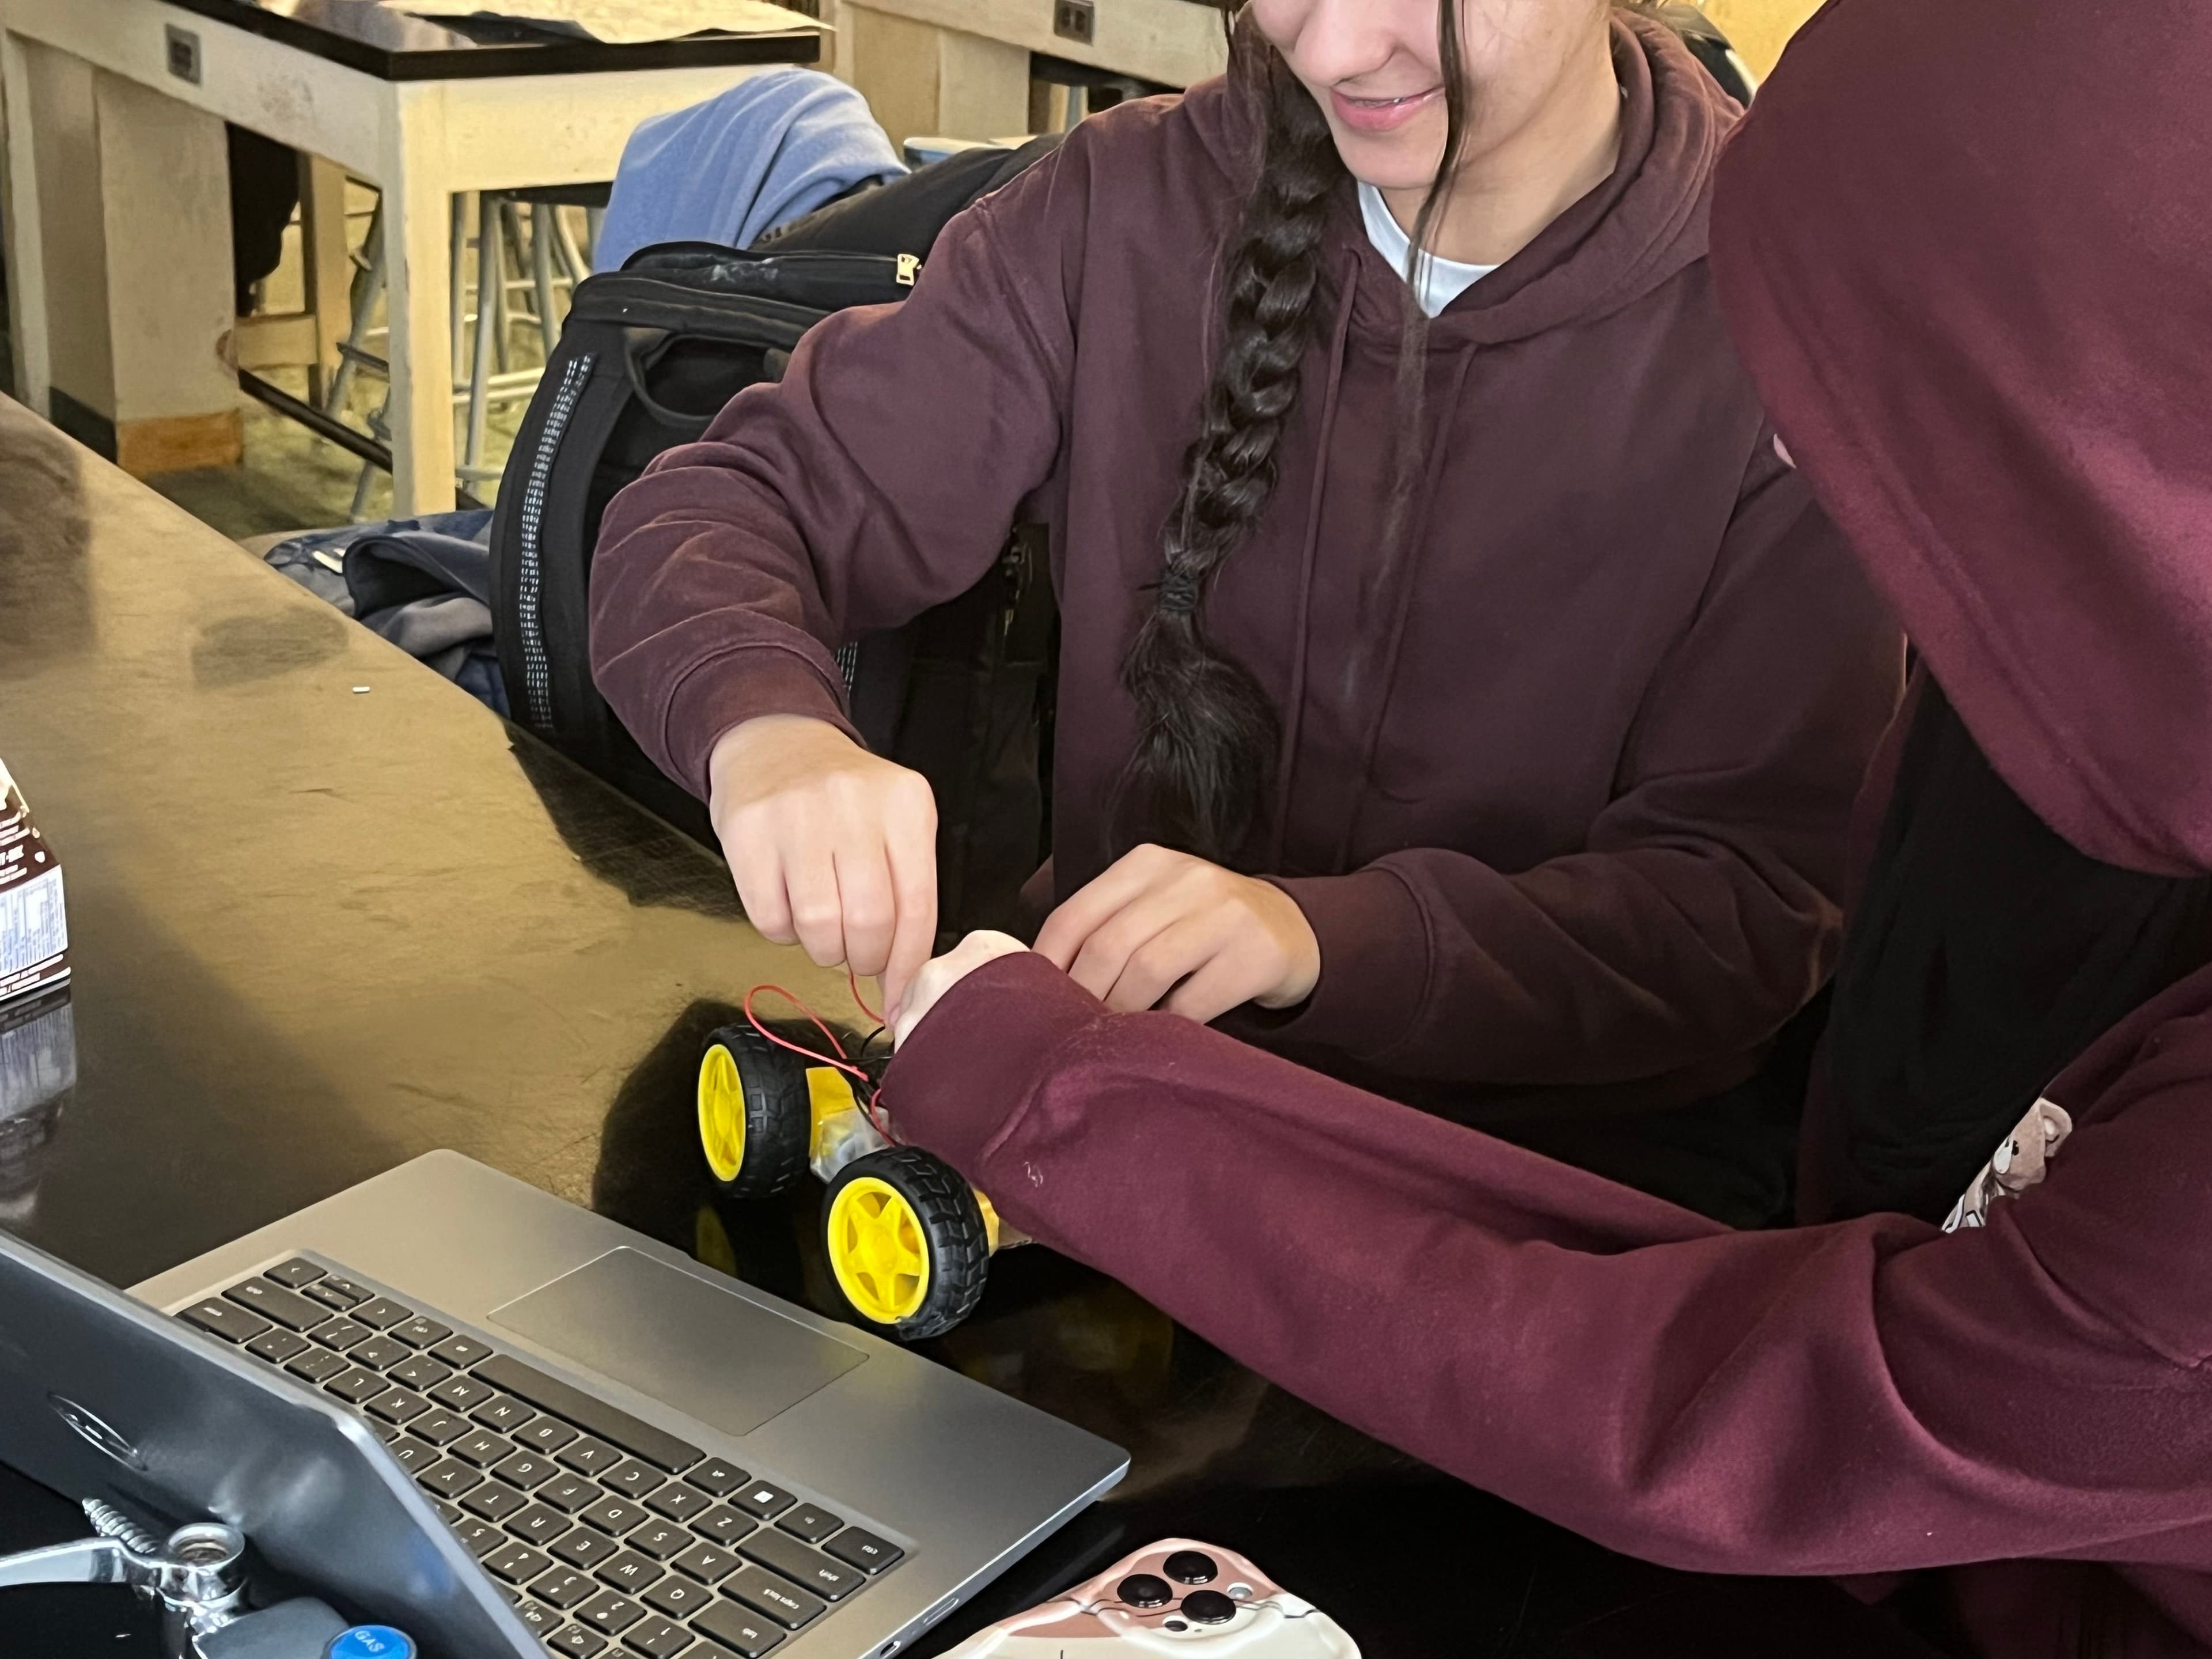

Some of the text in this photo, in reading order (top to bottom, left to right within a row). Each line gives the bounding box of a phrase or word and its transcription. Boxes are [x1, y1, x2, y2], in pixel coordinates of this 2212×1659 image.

[391, 1398, 406, 1408] K
[494, 1407, 511, 1416] N
[474, 1441, 490, 1450] H
[398, 1449, 414, 1459] U
[581, 1450, 594, 1459] V
[517, 1463, 532, 1472] G
[441, 1472, 456, 1481] Y
[625, 1471, 639, 1481] C
[484, 1495, 499, 1504] T
[671, 1494, 686, 1505] X
[608, 1509, 623, 1518] D
[531, 1517, 546, 1528] R
[717, 1517, 733, 1527] Z
[653, 1532, 668, 1541] S
[702, 1555, 716, 1565] A
[619, 1564, 638, 1576] W
[670, 1588, 685, 1600] Q
[355, 1631, 385, 1652] GAS
